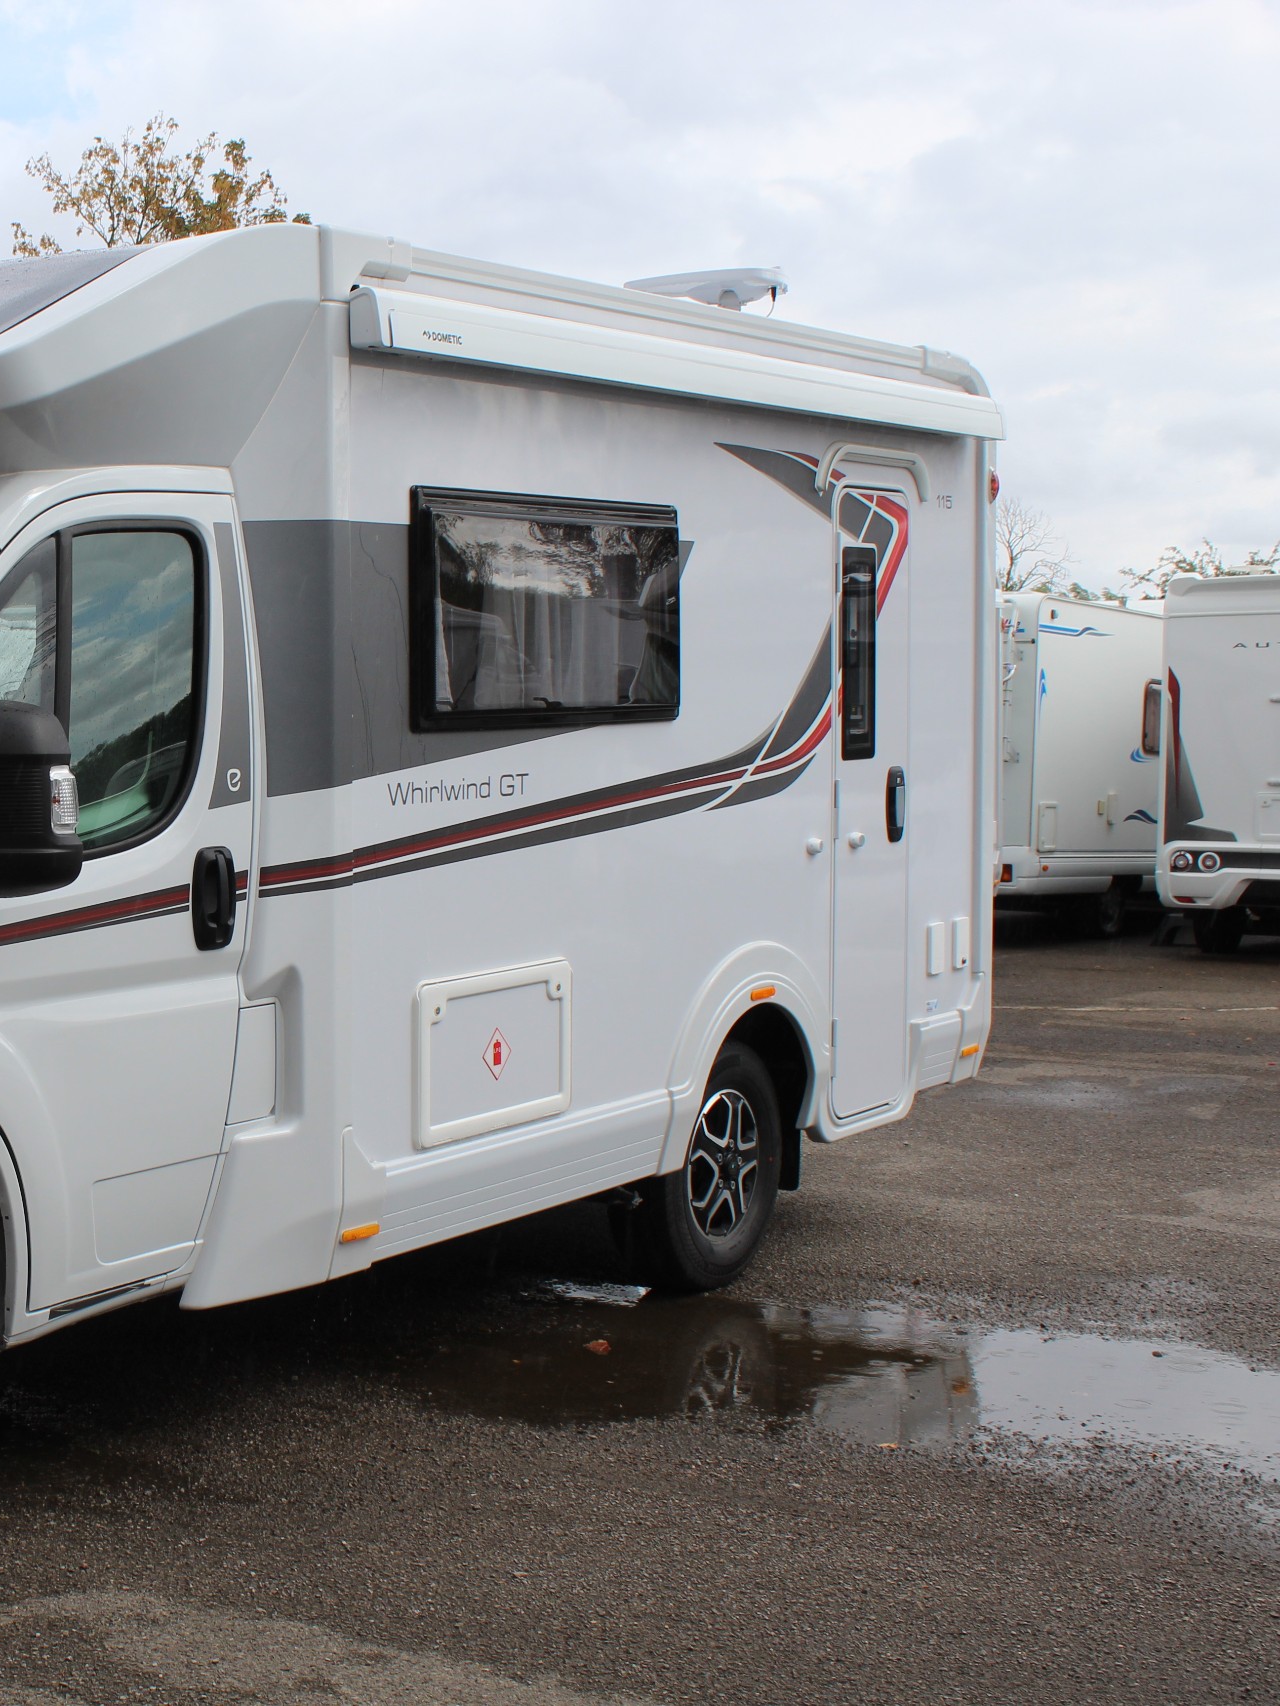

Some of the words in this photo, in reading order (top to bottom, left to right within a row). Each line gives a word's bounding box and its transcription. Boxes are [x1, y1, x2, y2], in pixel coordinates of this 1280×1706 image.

[431, 331, 463, 345] DOMETIC
[936, 494, 953, 509] 115
[1232, 641, 1280, 649] AU
[387, 776, 491, 806] Whirlwind
[499, 773, 529, 797] GT
